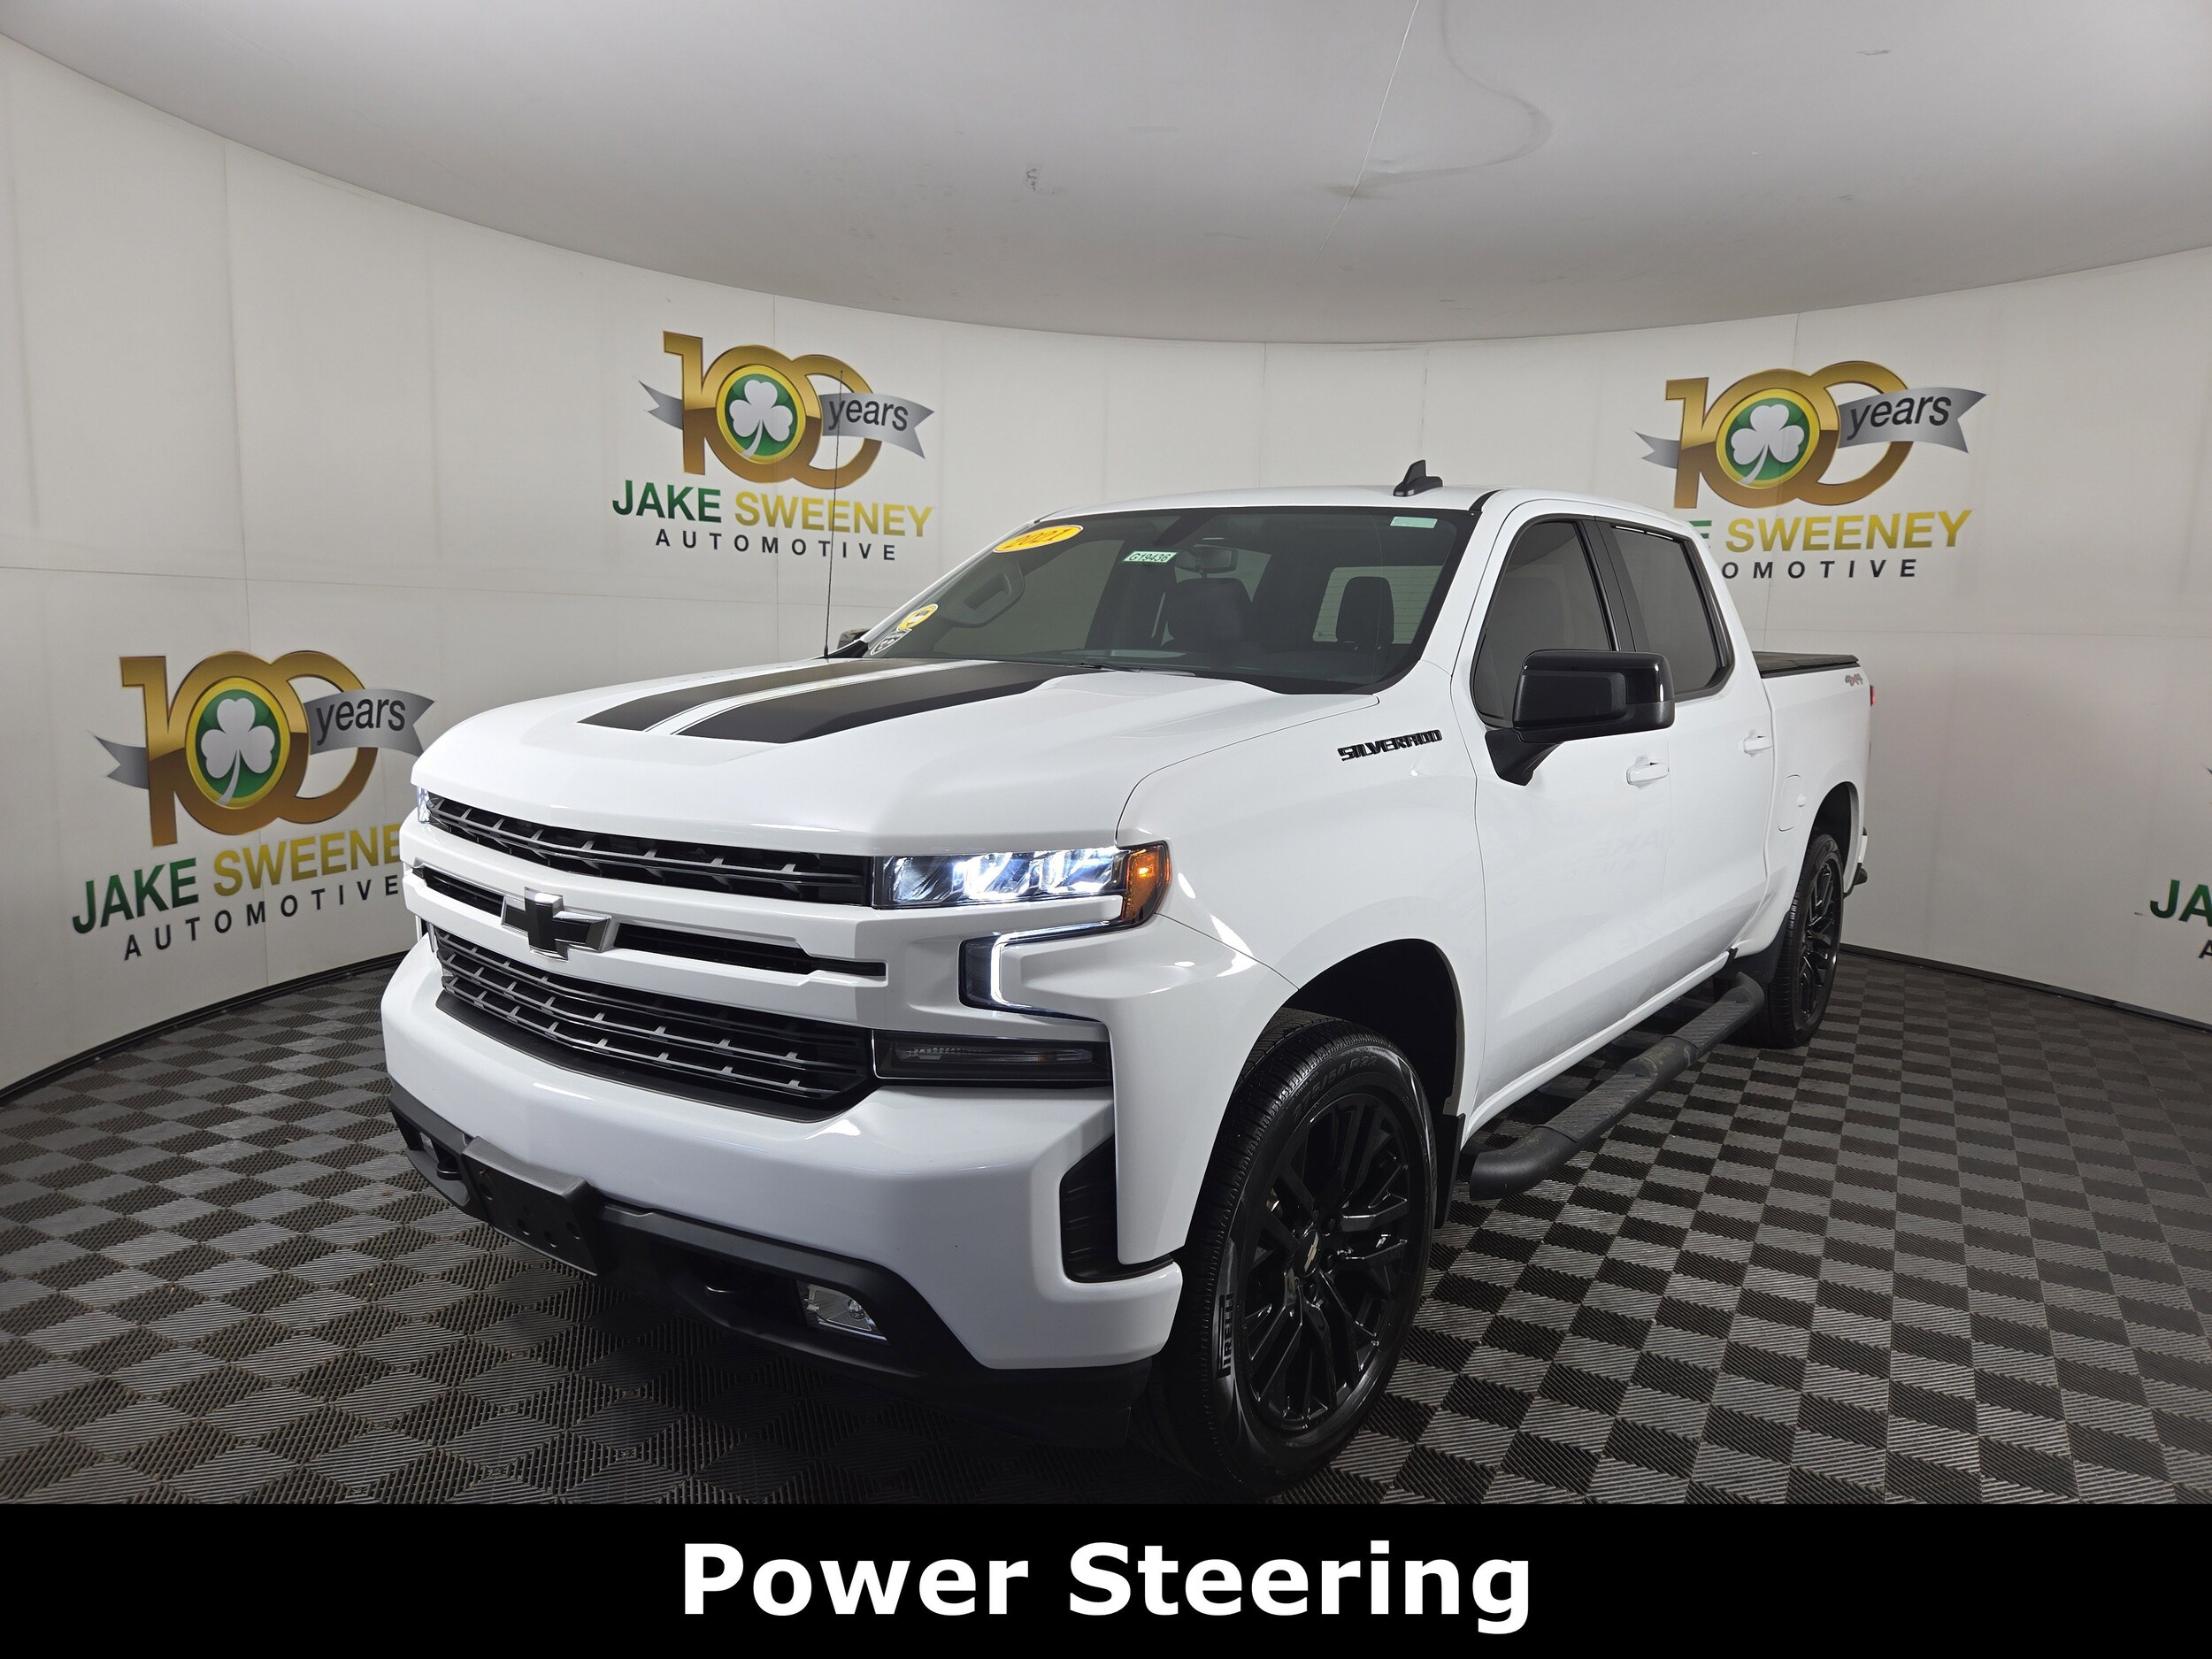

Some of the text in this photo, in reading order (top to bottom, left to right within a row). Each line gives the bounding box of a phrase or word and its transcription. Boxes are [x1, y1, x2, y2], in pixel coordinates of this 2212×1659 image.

[663, 330, 883, 489] 100
[828, 399, 910, 432] years
[1847, 395, 1952, 442] years
[1665, 360, 1915, 509] 100
[612, 480, 933, 538] JAKE SWEENEY
[1725, 509, 1973, 553] SWEENEY
[655, 528, 895, 561] AUTOMOTIVE
[1129, 553, 1171, 562] G19436
[1722, 559, 1917, 580] OMOTIVE
[315, 697, 407, 746] years
[1337, 729, 1443, 762] SILVERADO
[119, 650, 379, 848] 100
[72, 823, 401, 935] JAKE SWEENE
[2150, 879, 2212, 927] JA
[124, 874, 399, 961] AUTOMOTIVE
[1217, 1293, 1234, 1379] PIRELLI
